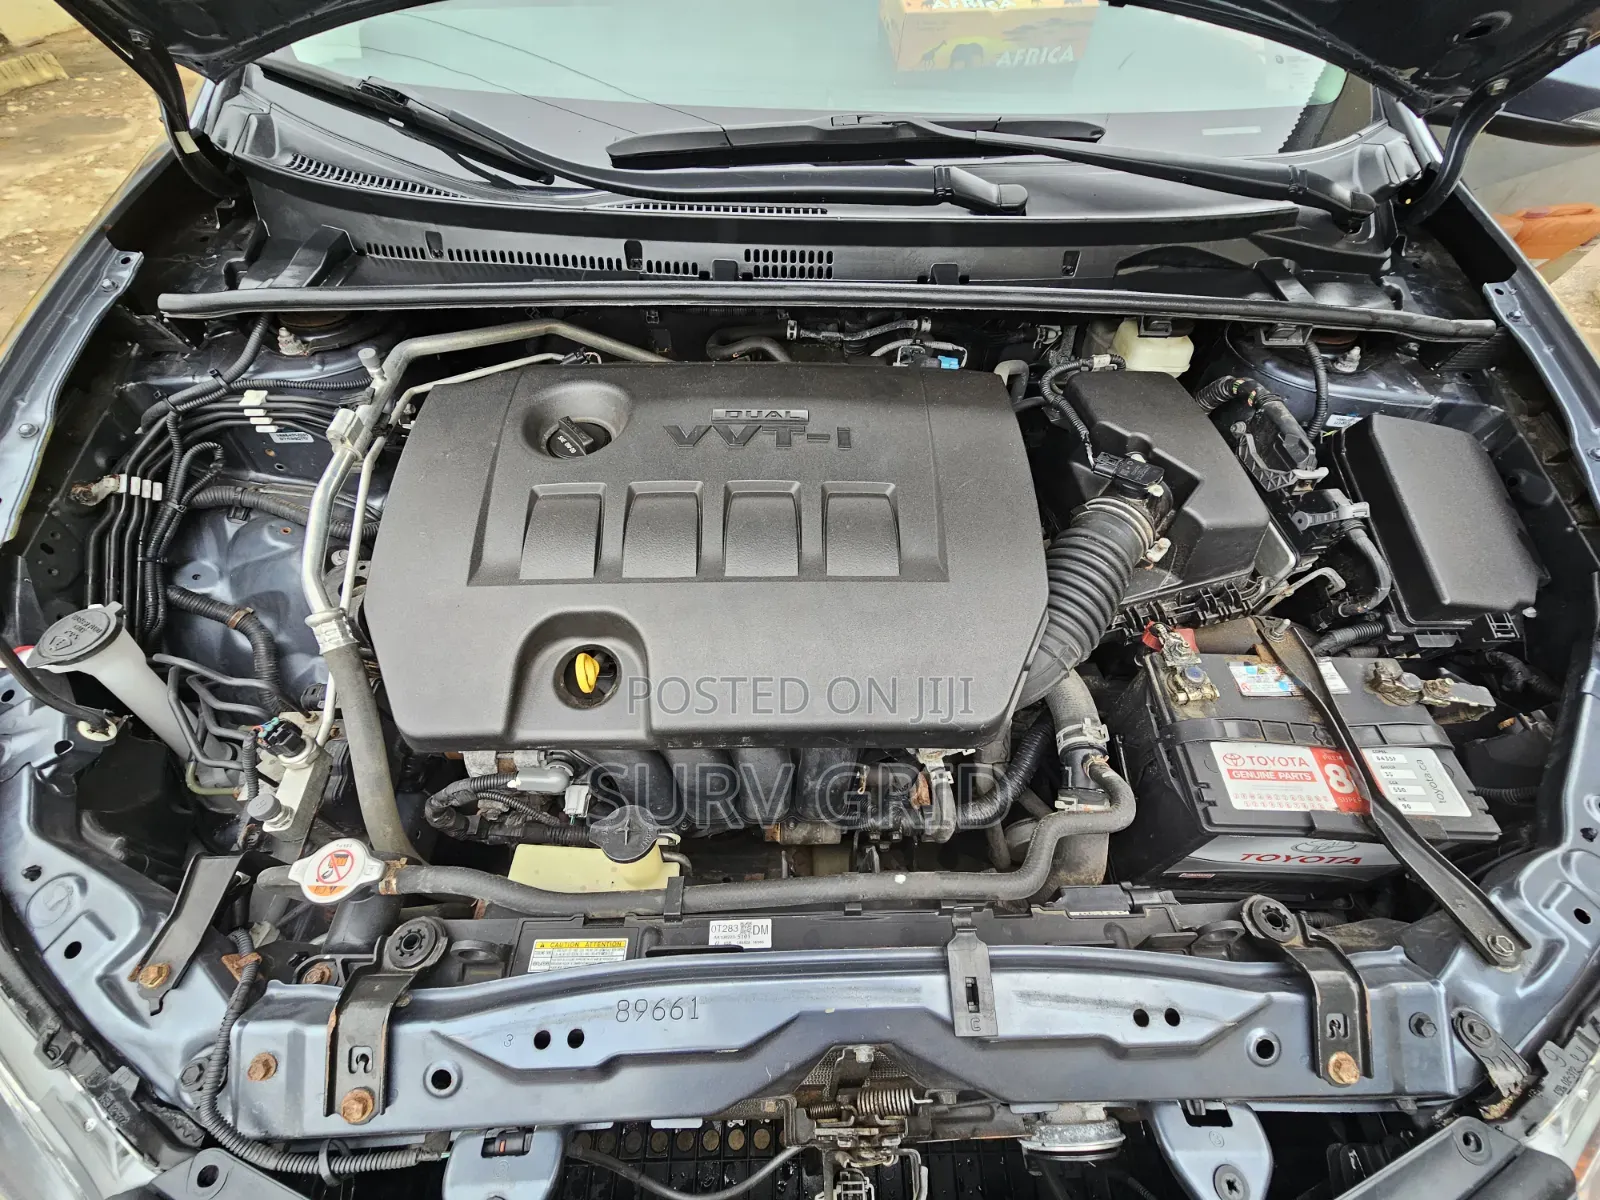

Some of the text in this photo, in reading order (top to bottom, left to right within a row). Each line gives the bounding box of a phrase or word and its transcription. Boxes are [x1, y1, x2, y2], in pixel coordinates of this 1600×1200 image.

[997, 45, 1074, 67] AFRICA
[724, 409, 805, 419] DUAL
[1246, 755, 1310, 767] TOYOTA
[1231, 770, 1313, 781] GENUINE PARTS
[1416, 759, 1447, 804] toyota.ca
[1240, 853, 1363, 865] TOYOTA
[753, 924, 769, 936] DM
[584, 941, 622, 949] ATTENTION
[615, 996, 699, 1023] 89661
